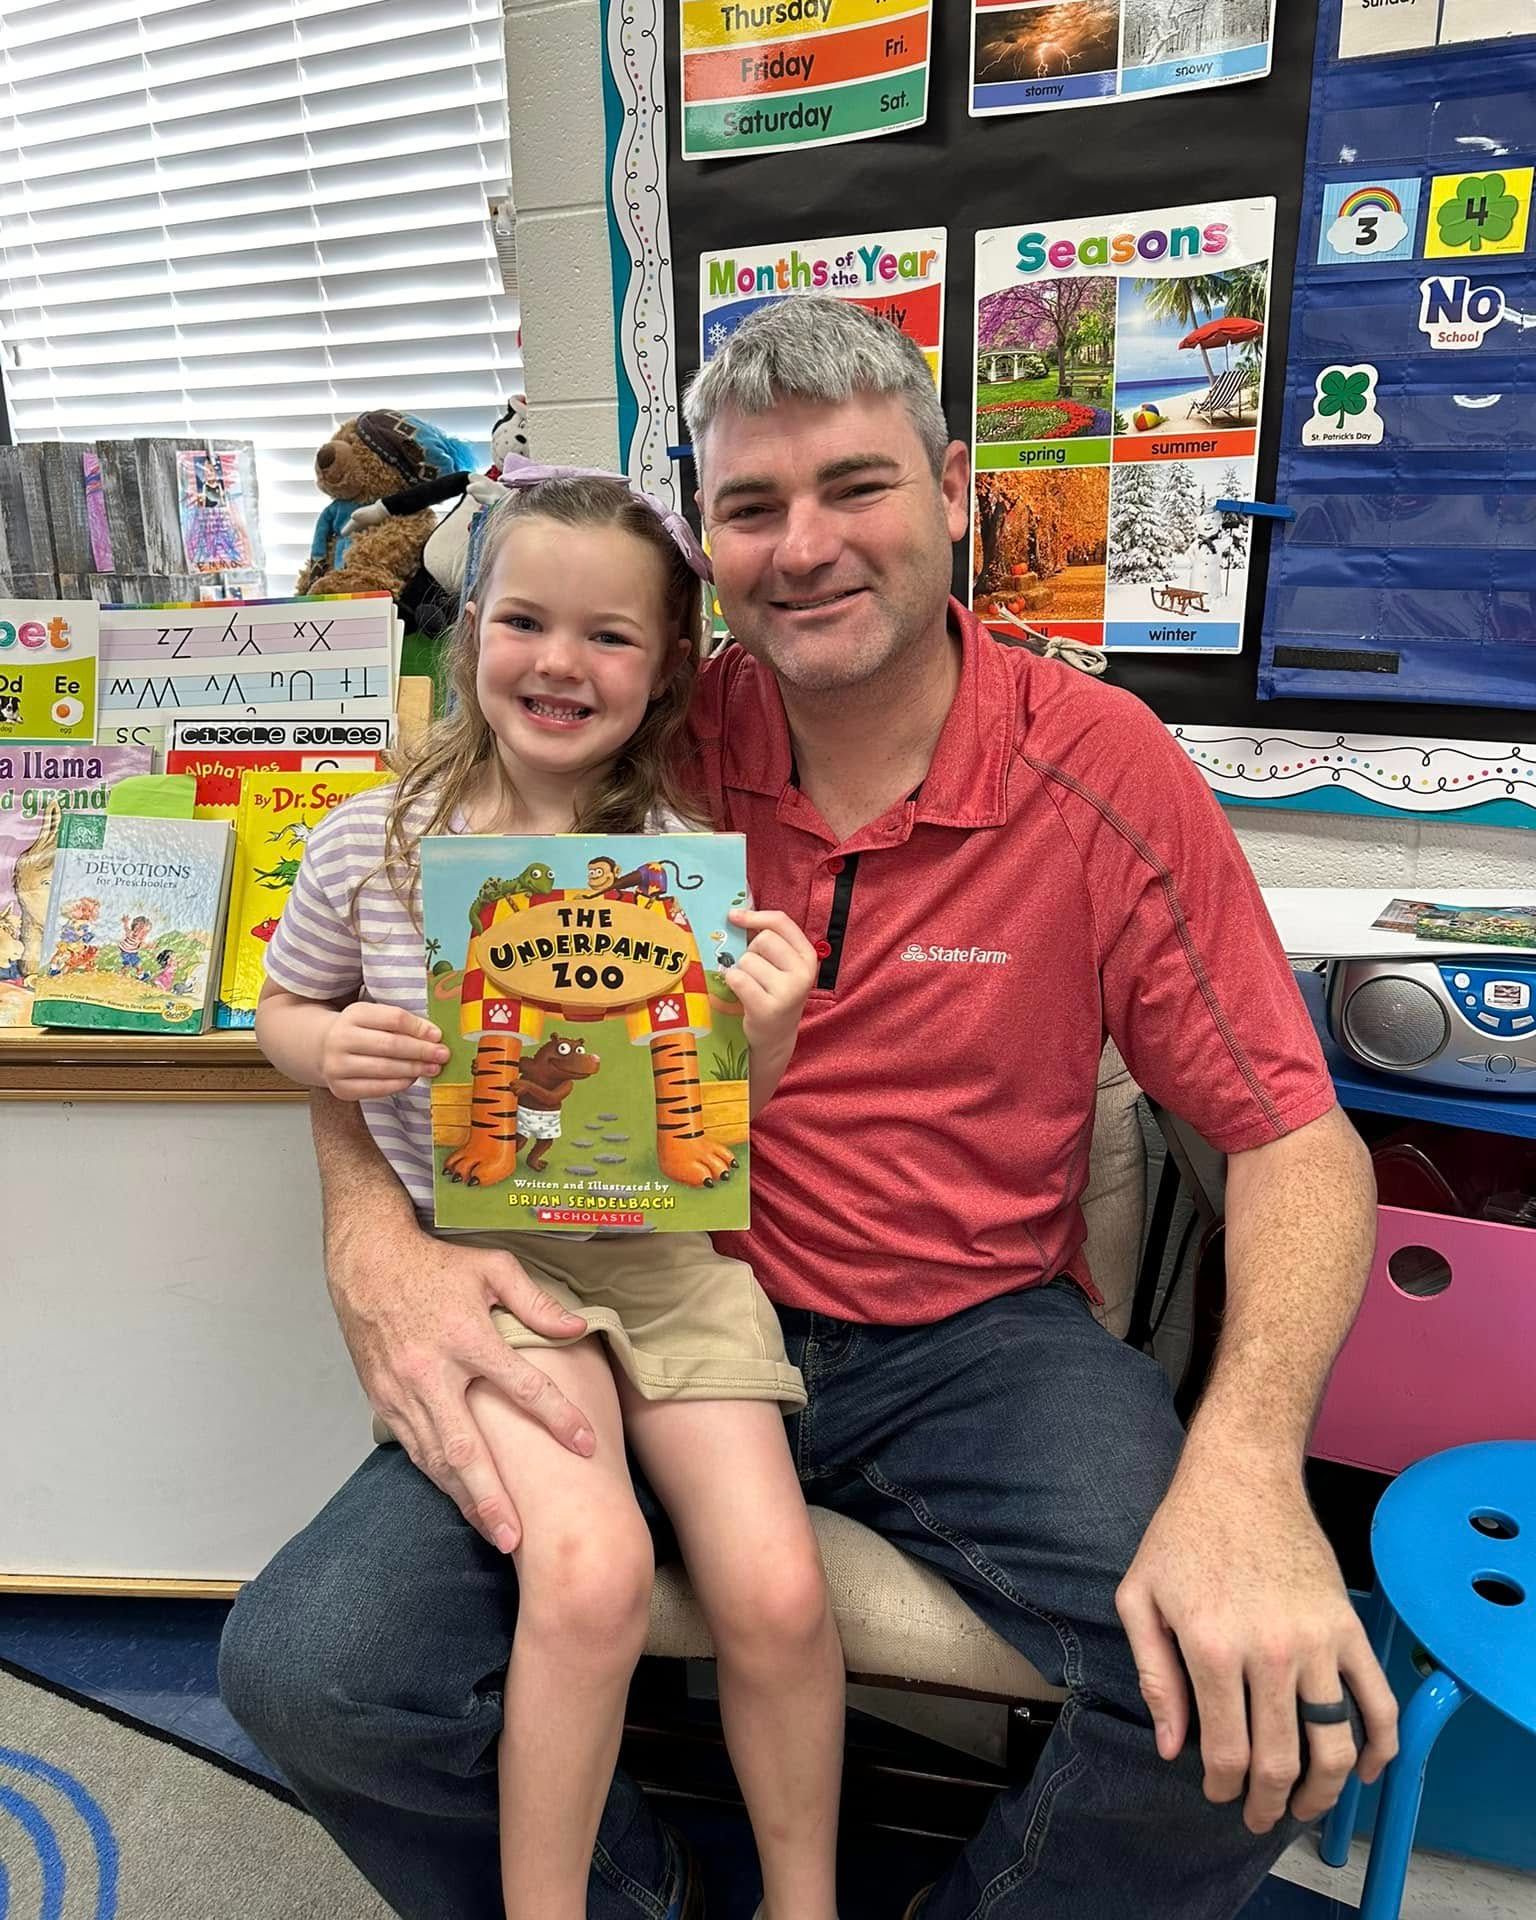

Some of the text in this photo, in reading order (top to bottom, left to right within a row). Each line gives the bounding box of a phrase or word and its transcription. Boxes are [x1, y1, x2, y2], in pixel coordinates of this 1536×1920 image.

[721, 0, 832, 31] Thursday
[741, 36, 908, 82] Friday Fri.
[1175, 61, 1214, 78] snowy
[1025, 83, 1064, 98] stormy
[724, 91, 909, 136] Saturday Sat.
[1465, 196, 1488, 227] 4
[1356, 217, 1378, 246] 3
[1016, 223, 1229, 273] Seasons
[709, 244, 936, 296] Months of the Year
[1426, 278, 1501, 324] No
[1438, 331, 1479, 344] School
[1151, 438, 1218, 455] summer
[1323, 433, 1354, 441] Patrick's
[1356, 433, 1372, 441] Day
[1019, 446, 1066, 464] spring
[1149, 627, 1197, 642] winter
[55, 676, 80, 694] Ee
[23, 752, 102, 779] llama
[185, 761, 280, 779] AlphaTles
[22, 783, 111, 819] grand
[254, 794, 272, 808] By
[272, 787, 307, 813] Dr.
[86, 861, 191, 879] DEVOTIONS
[96, 875, 178, 889] for Preschoolers
[557, 908, 612, 928] THE
[489, 933, 688, 974] UNDERPANTS
[552, 962, 624, 990] ZOO
[514, 1179, 670, 1194] Written and Illustrated by
[509, 1193, 676, 1210] BRIAN SENDELBACH
[553, 1212, 642, 1223] SCHOLASTIC
